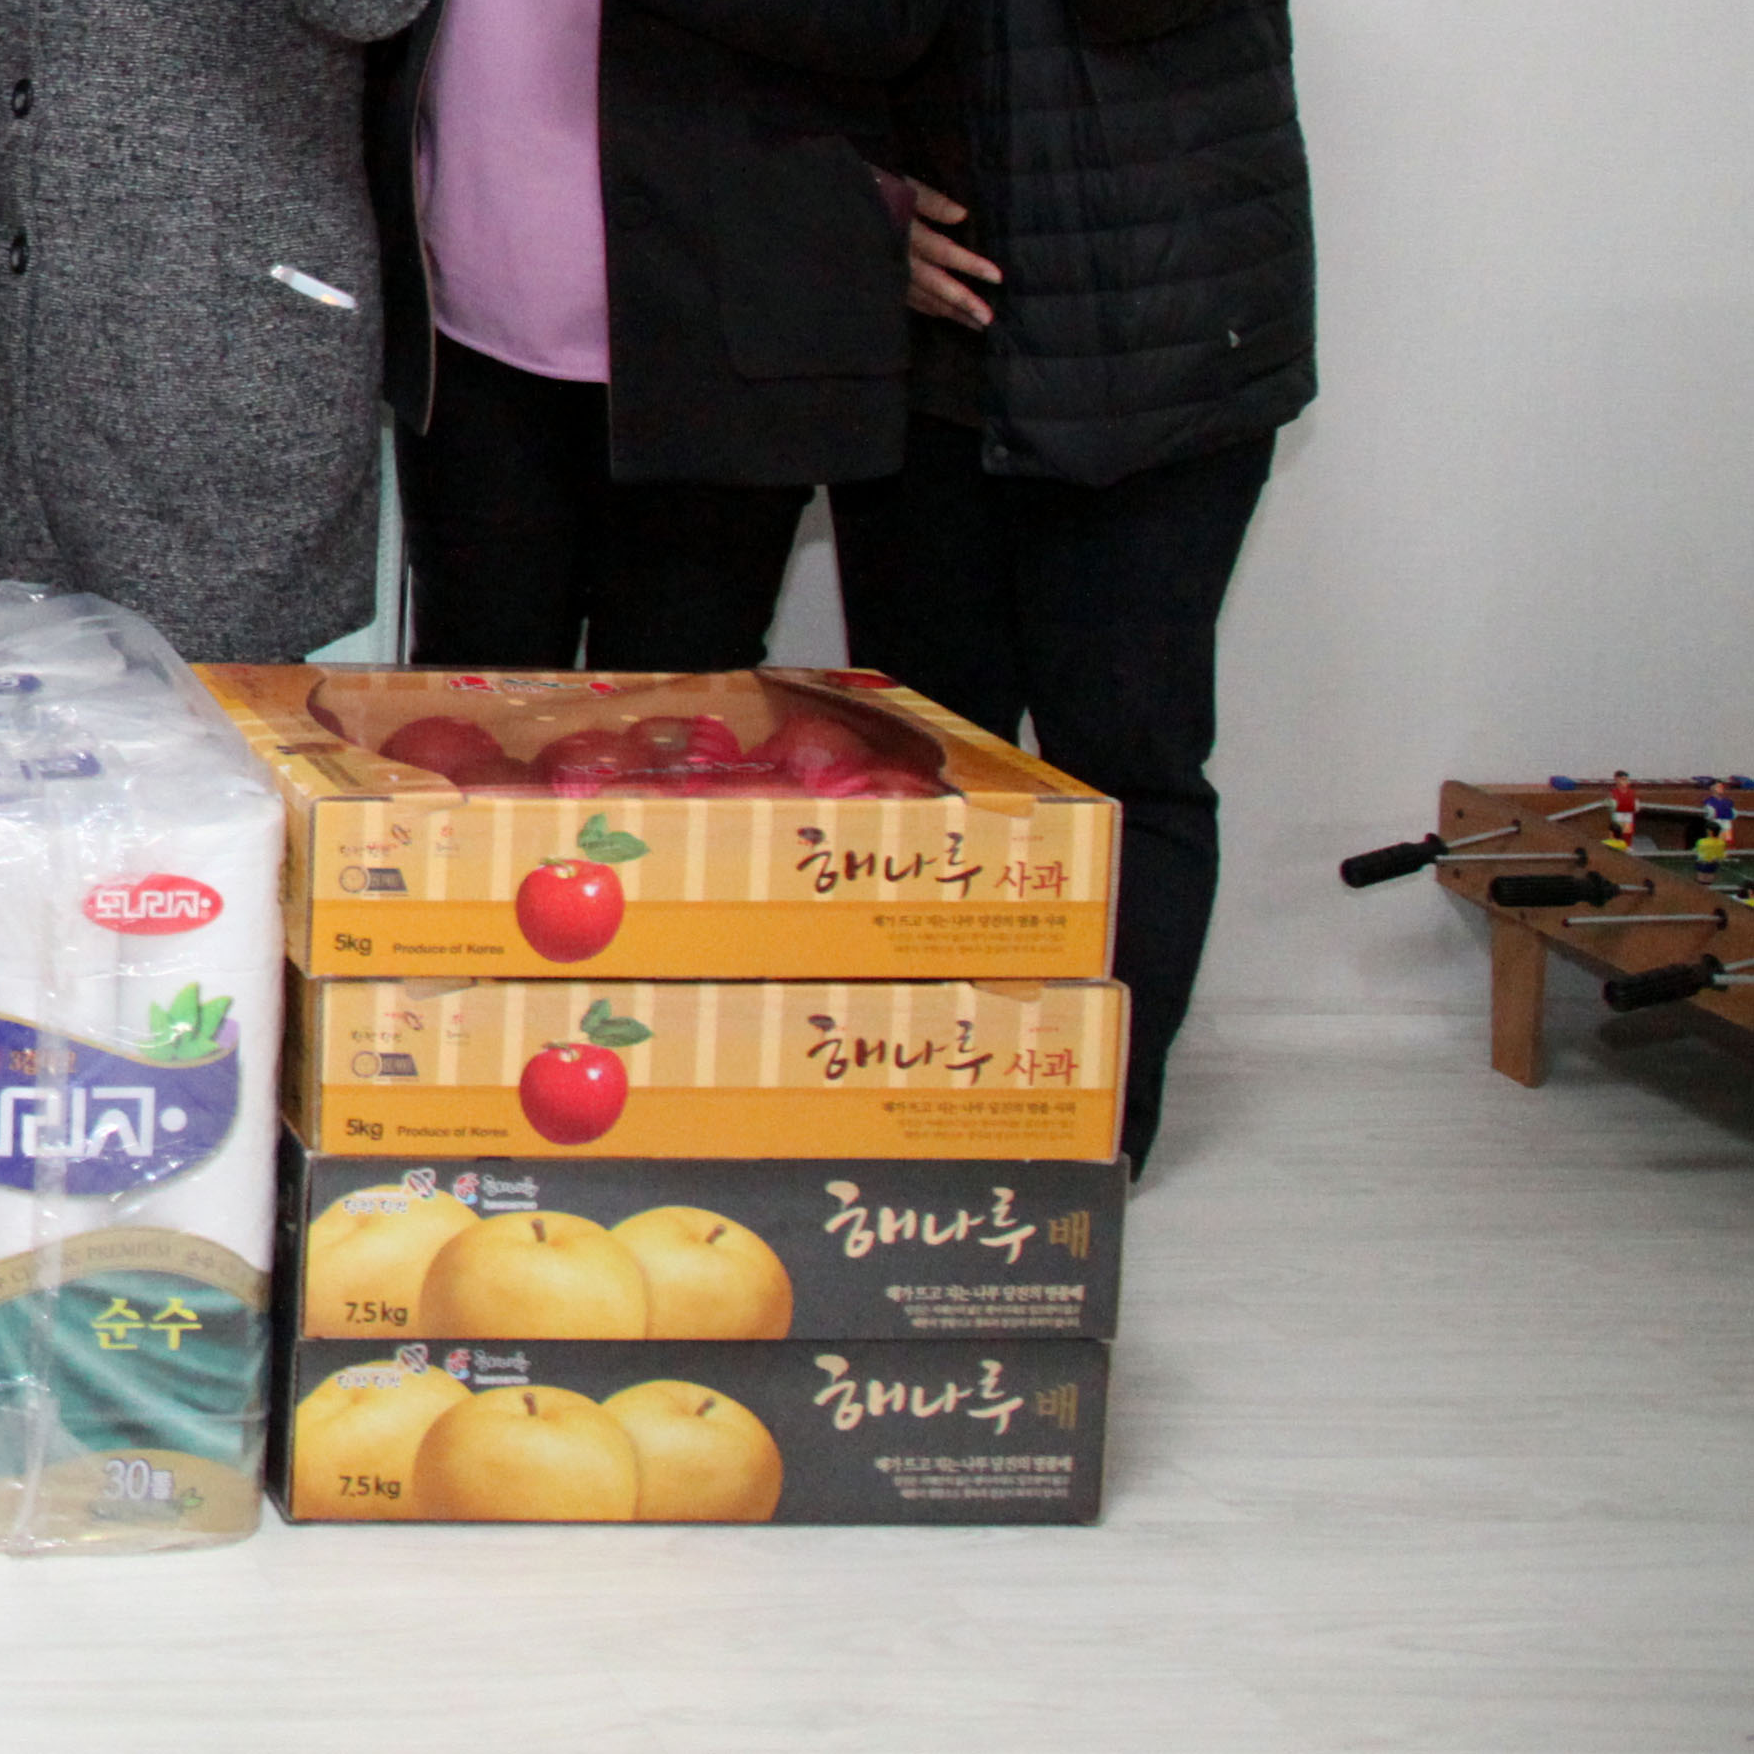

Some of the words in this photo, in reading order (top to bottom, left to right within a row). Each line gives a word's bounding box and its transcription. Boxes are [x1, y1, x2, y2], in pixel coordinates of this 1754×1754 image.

[795, 827, 984, 899] 해나루
[994, 859, 1070, 899] 사과
[334, 932, 373, 957] 5kg
[806, 1014, 994, 1087] 해나루
[1002, 1047, 1080, 1087] 사과
[346, 1117, 384, 1141] 5kg
[824, 1180, 1037, 1265] 해나루
[1047, 1209, 1091, 1260] 배
[92, 1297, 203, 1351] 순수
[813, 1354, 1025, 1436] 해나루
[1034, 1381, 1079, 1431] 배
